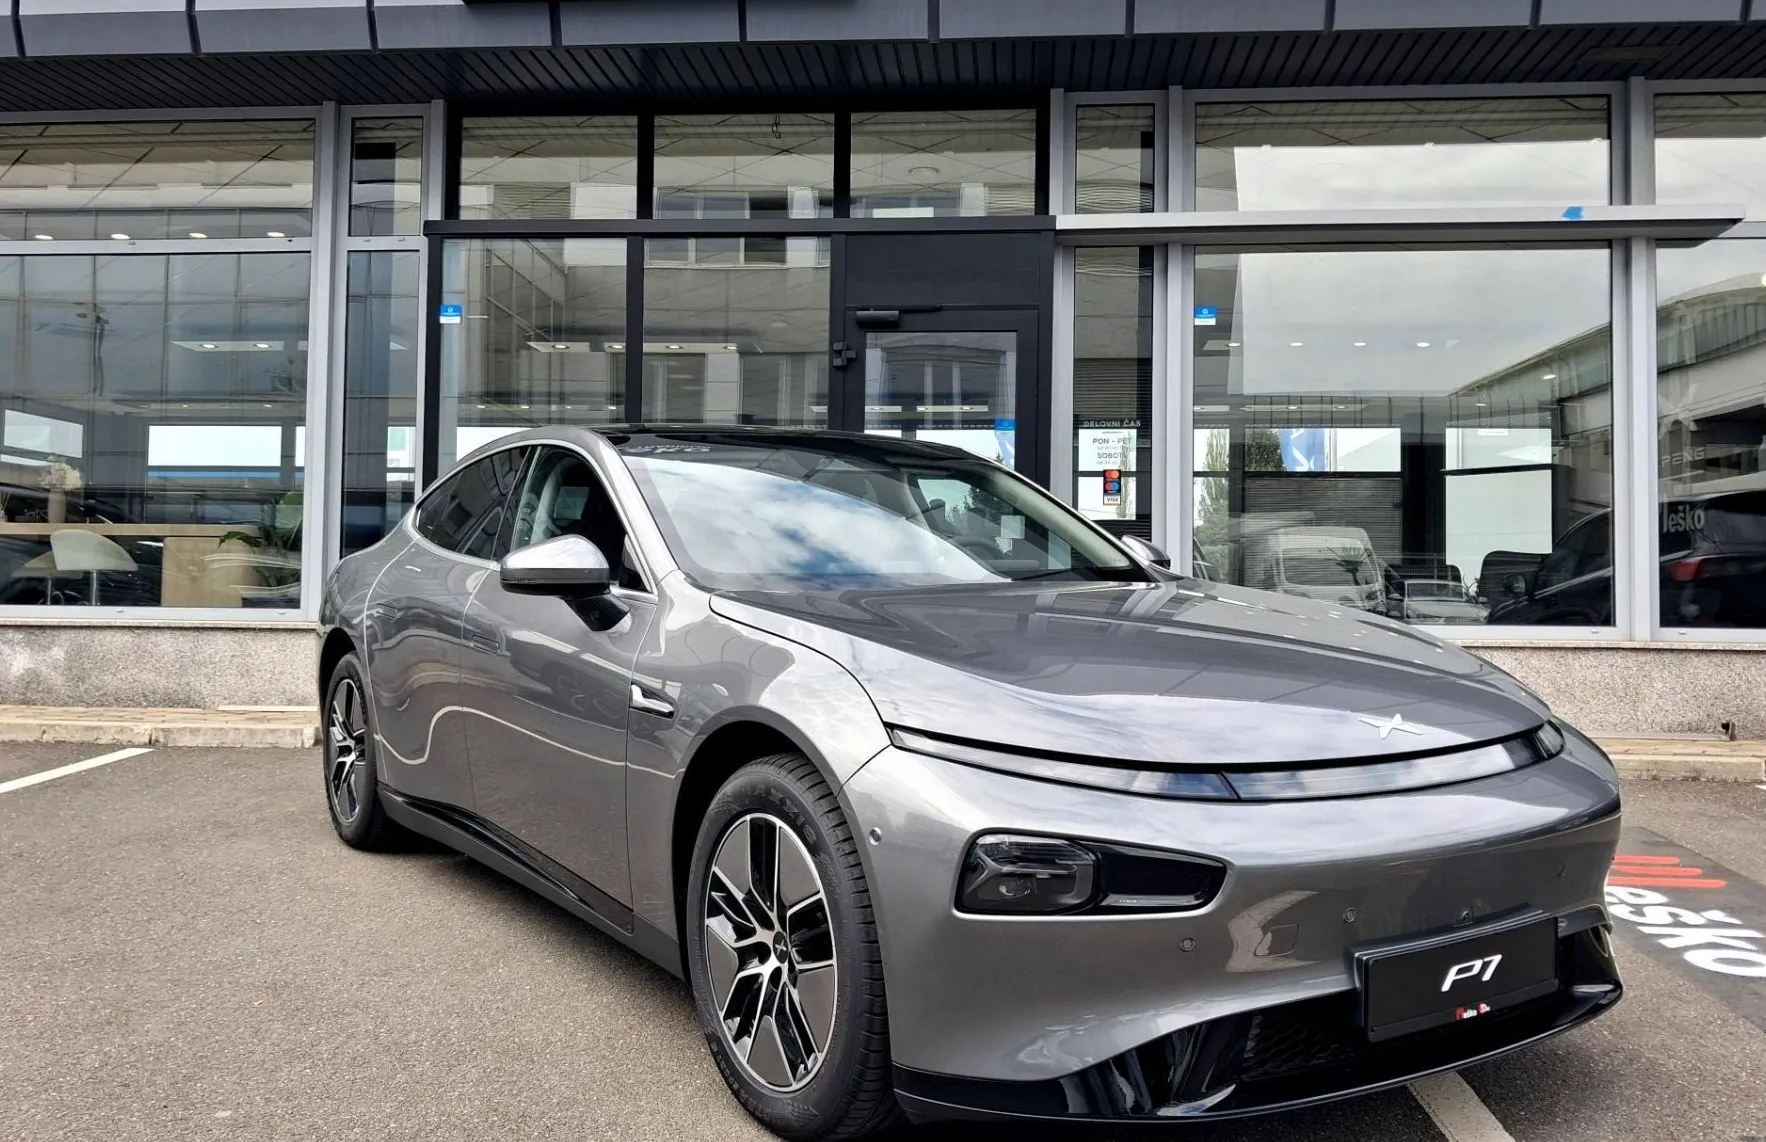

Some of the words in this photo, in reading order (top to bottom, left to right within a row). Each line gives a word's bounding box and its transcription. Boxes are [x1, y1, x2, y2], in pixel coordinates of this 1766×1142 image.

[1083, 420, 1121, 428] DELOVNI
[1123, 418, 1141, 427] ČAS
[1117, 437, 1132, 445] PET
[1661, 447, 1706, 468] PENG
[1440, 953, 1503, 993] P7
